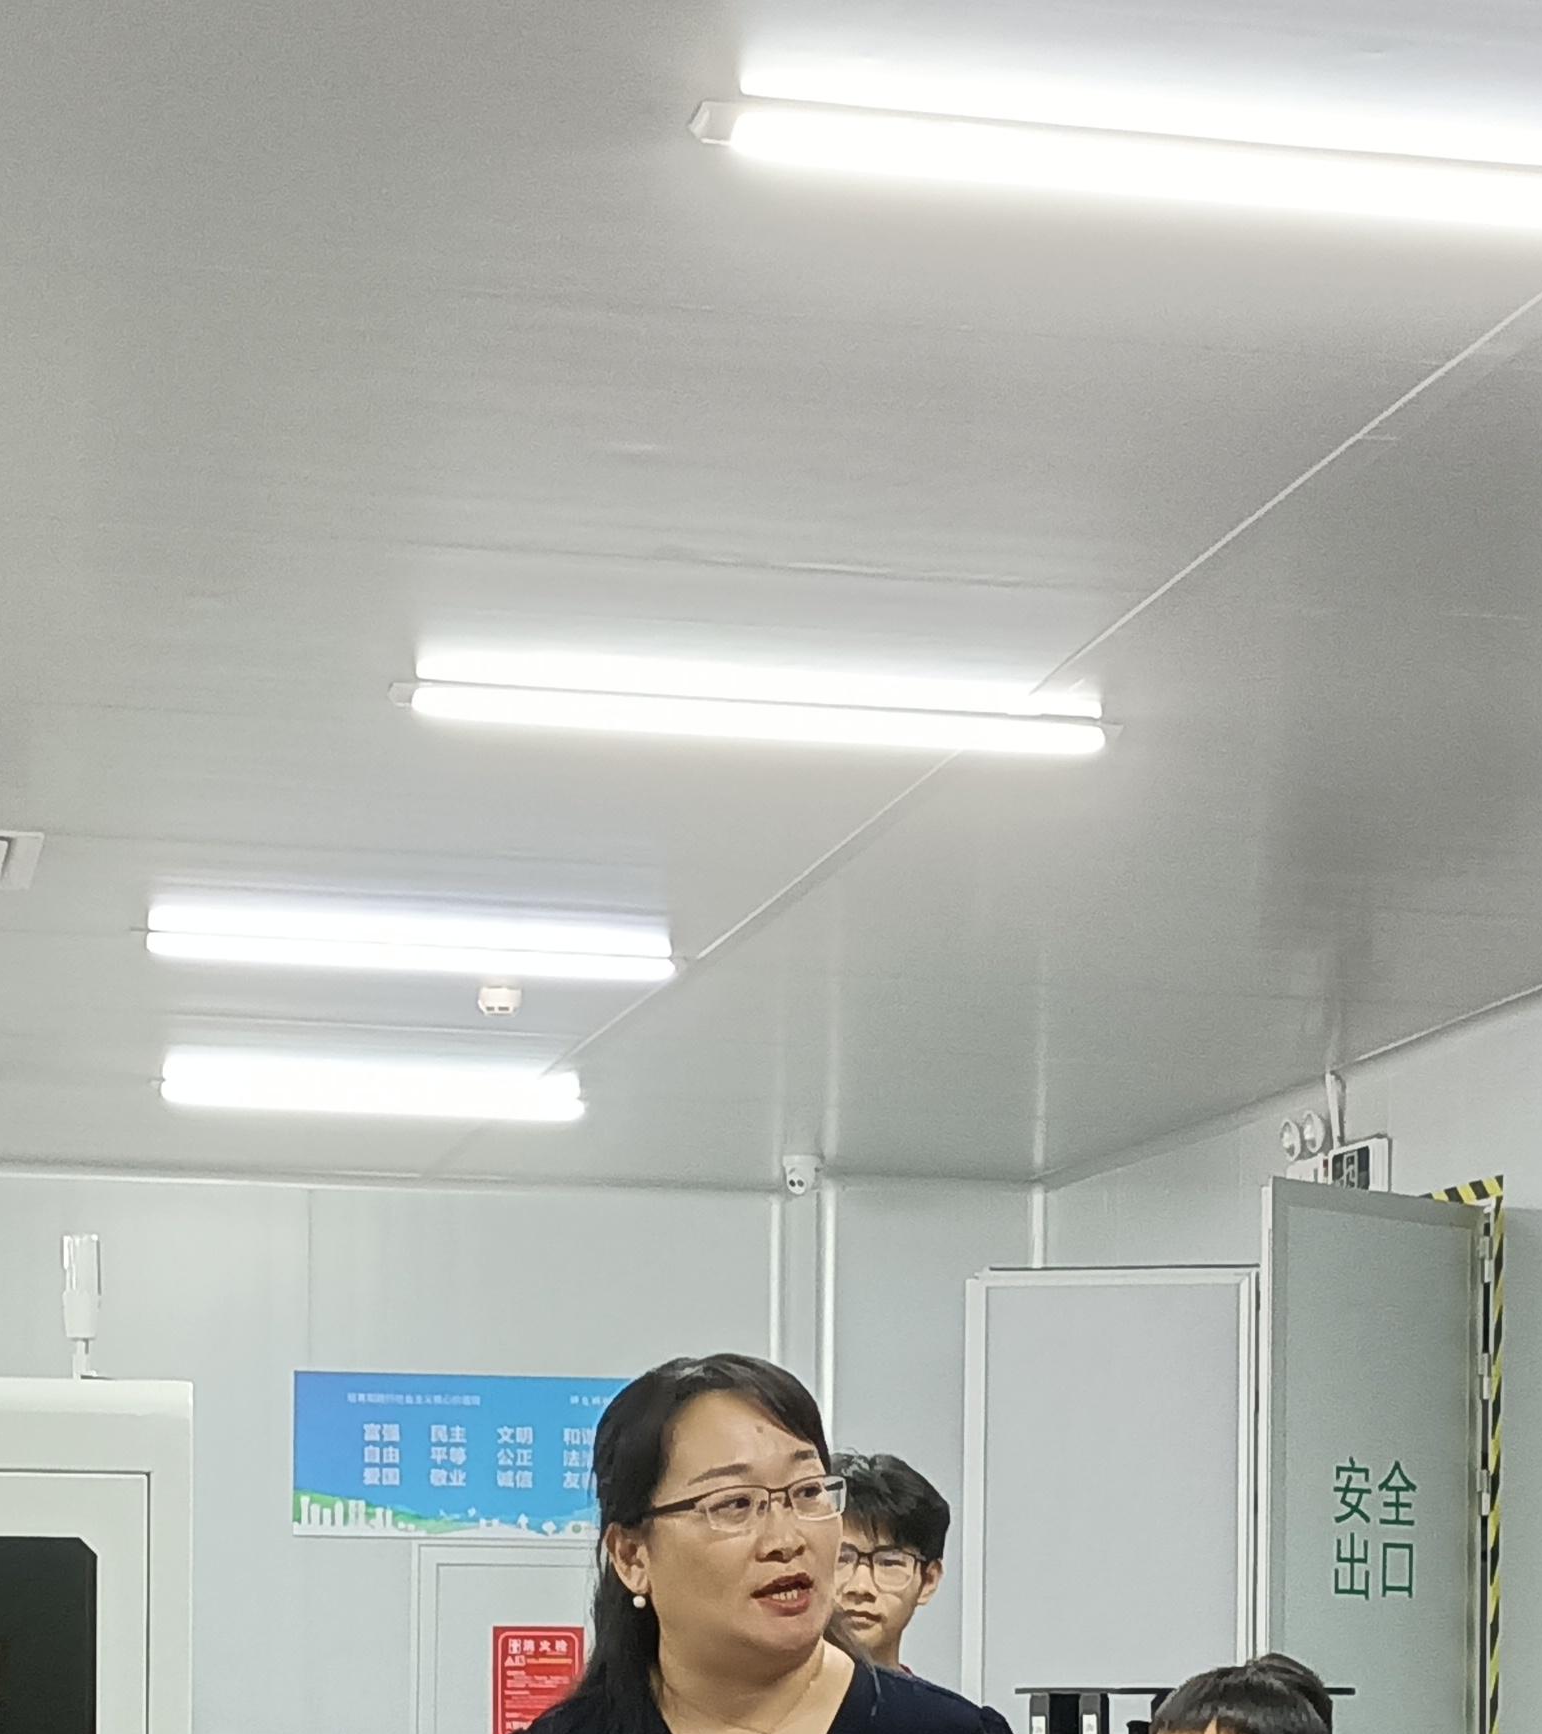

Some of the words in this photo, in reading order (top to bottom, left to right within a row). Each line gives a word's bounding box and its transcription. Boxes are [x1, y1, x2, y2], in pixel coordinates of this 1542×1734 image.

[363, 1423, 400, 1442] 富强
[430, 1424, 467, 1444] 民主
[497, 1426, 534, 1445] 文明
[363, 1445, 400, 1464] 自由
[430, 1446, 467, 1465] 平等
[497, 1448, 534, 1467] 公正
[363, 1467, 400, 1486] 爱国
[429, 1468, 467, 1487] 敬业
[496, 1469, 533, 1489] 诚信
[1333, 1456, 1417, 1526] 安全
[1334, 1532, 1414, 1600] 出口
